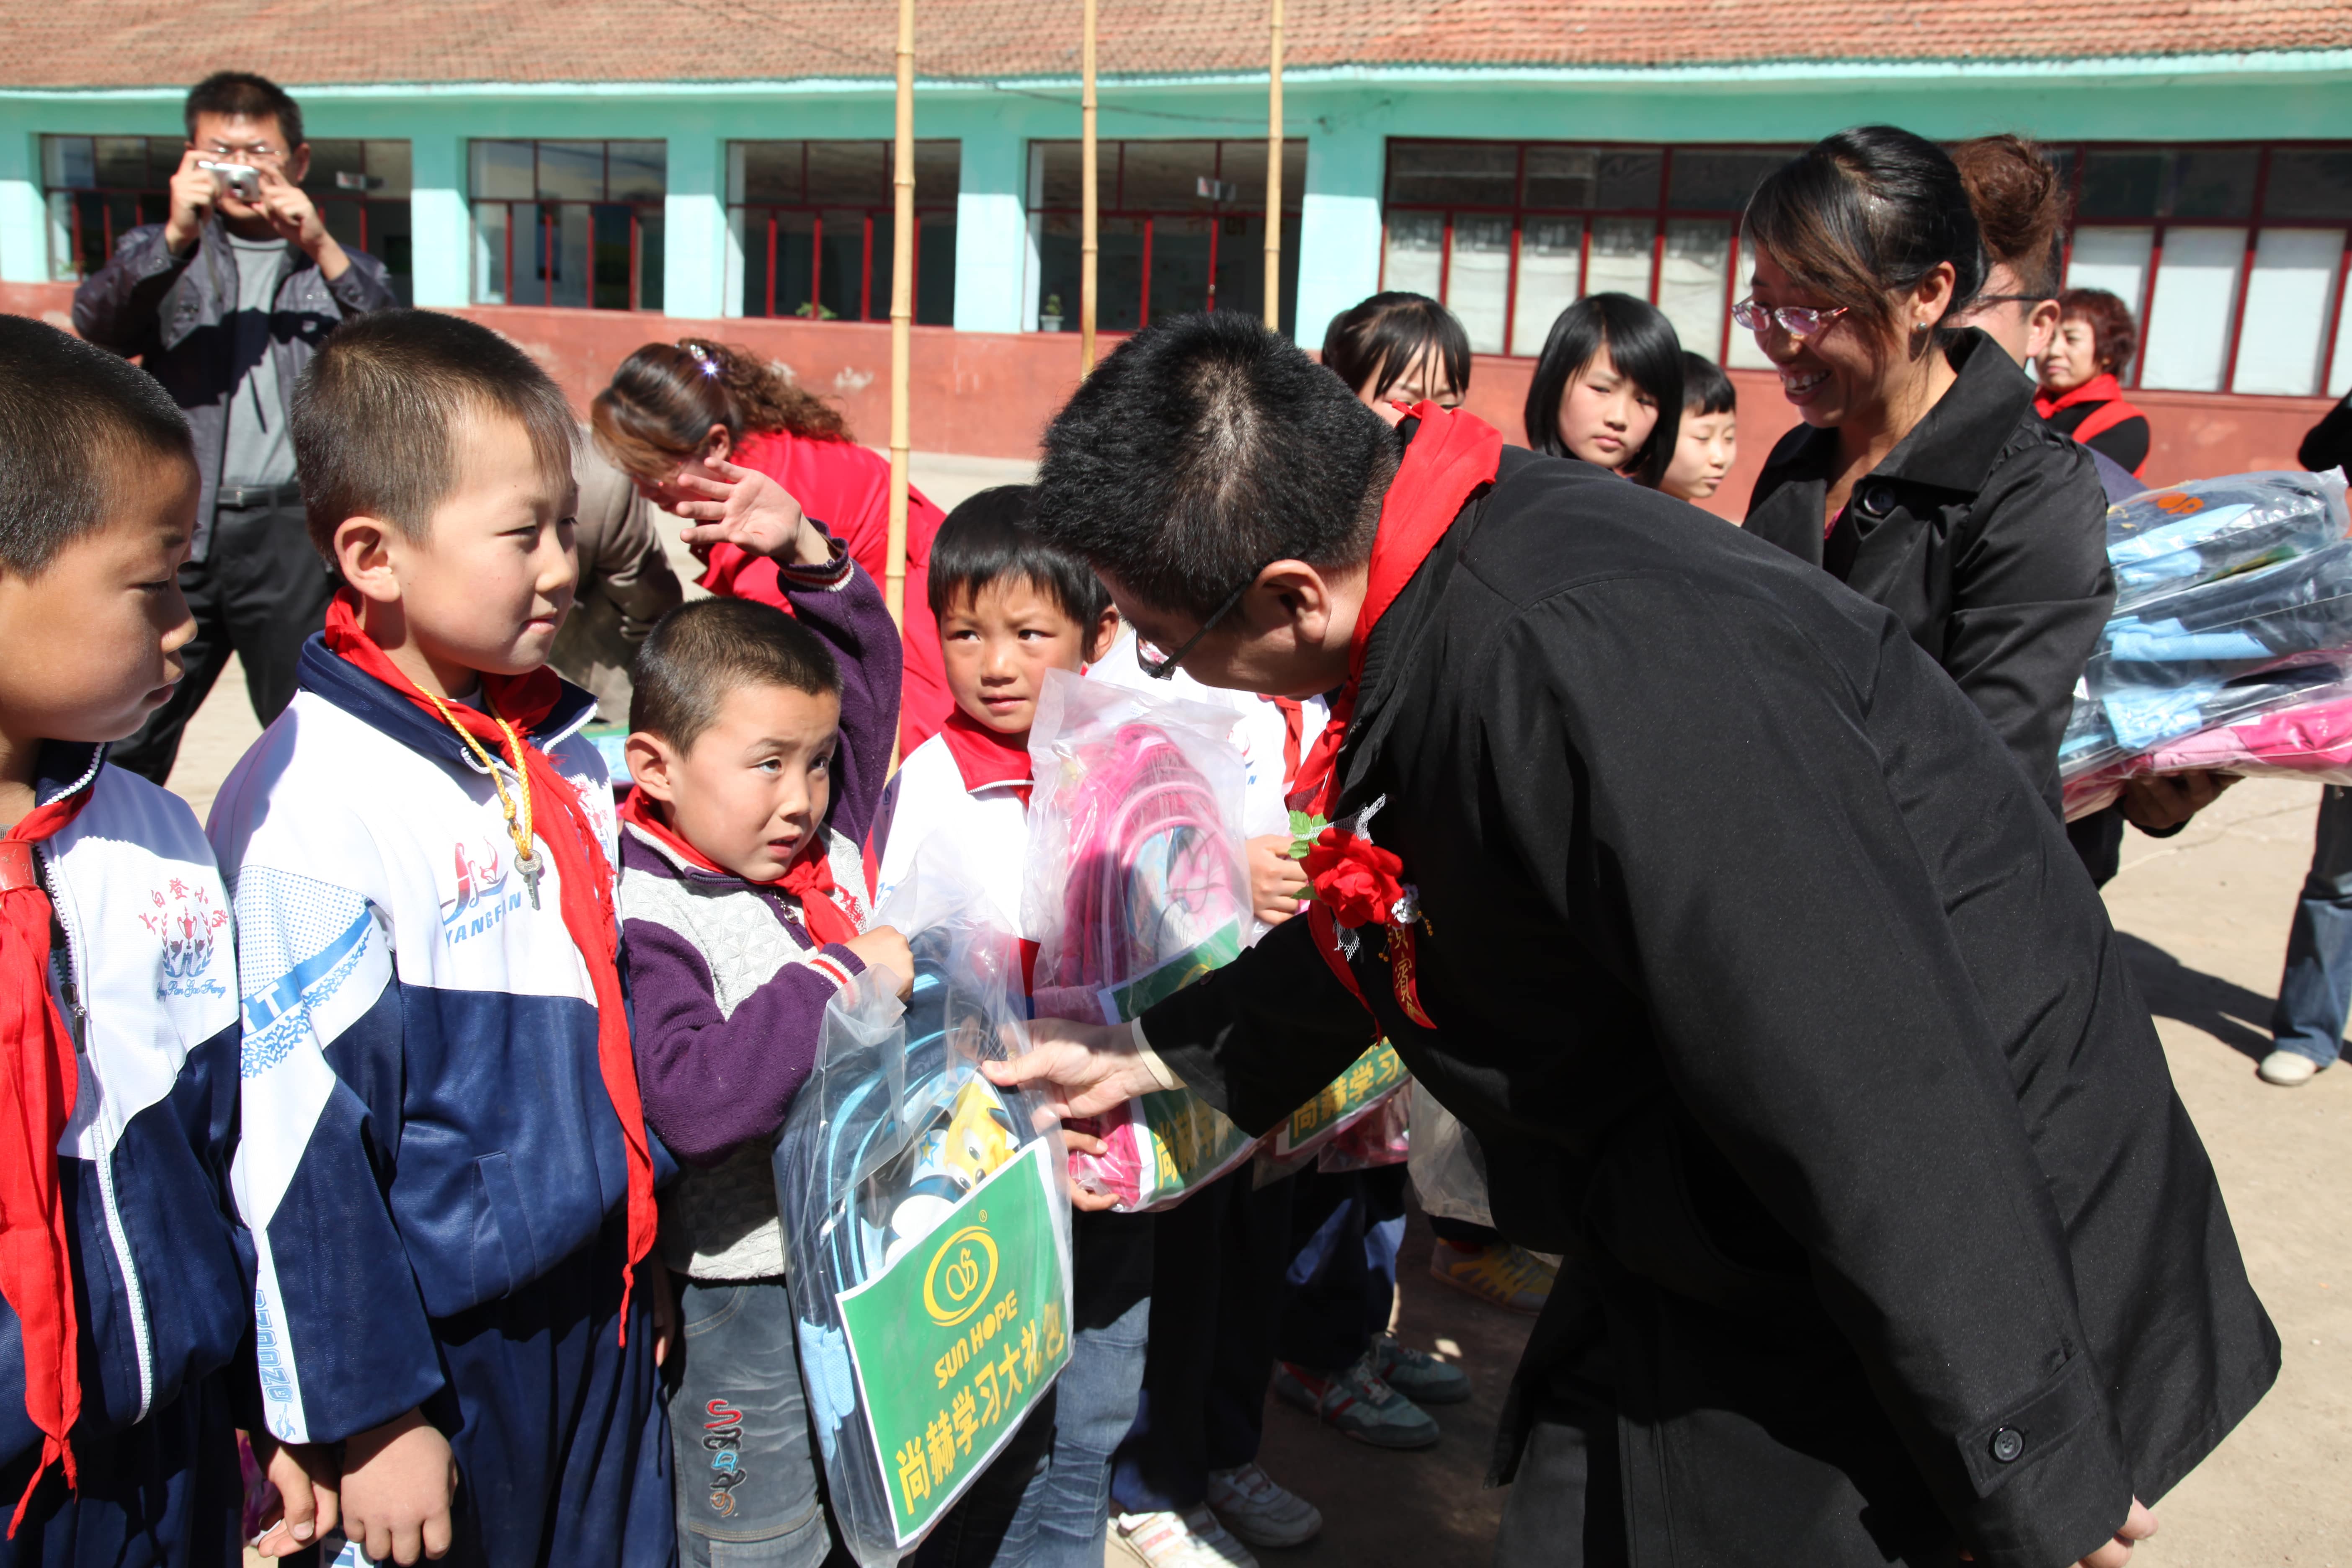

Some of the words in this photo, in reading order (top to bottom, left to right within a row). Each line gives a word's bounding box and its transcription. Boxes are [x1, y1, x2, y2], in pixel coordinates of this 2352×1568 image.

[970, 1289, 1018, 1355] HOPE
[895, 1302, 1065, 1516] 尚赫学习大礼包
